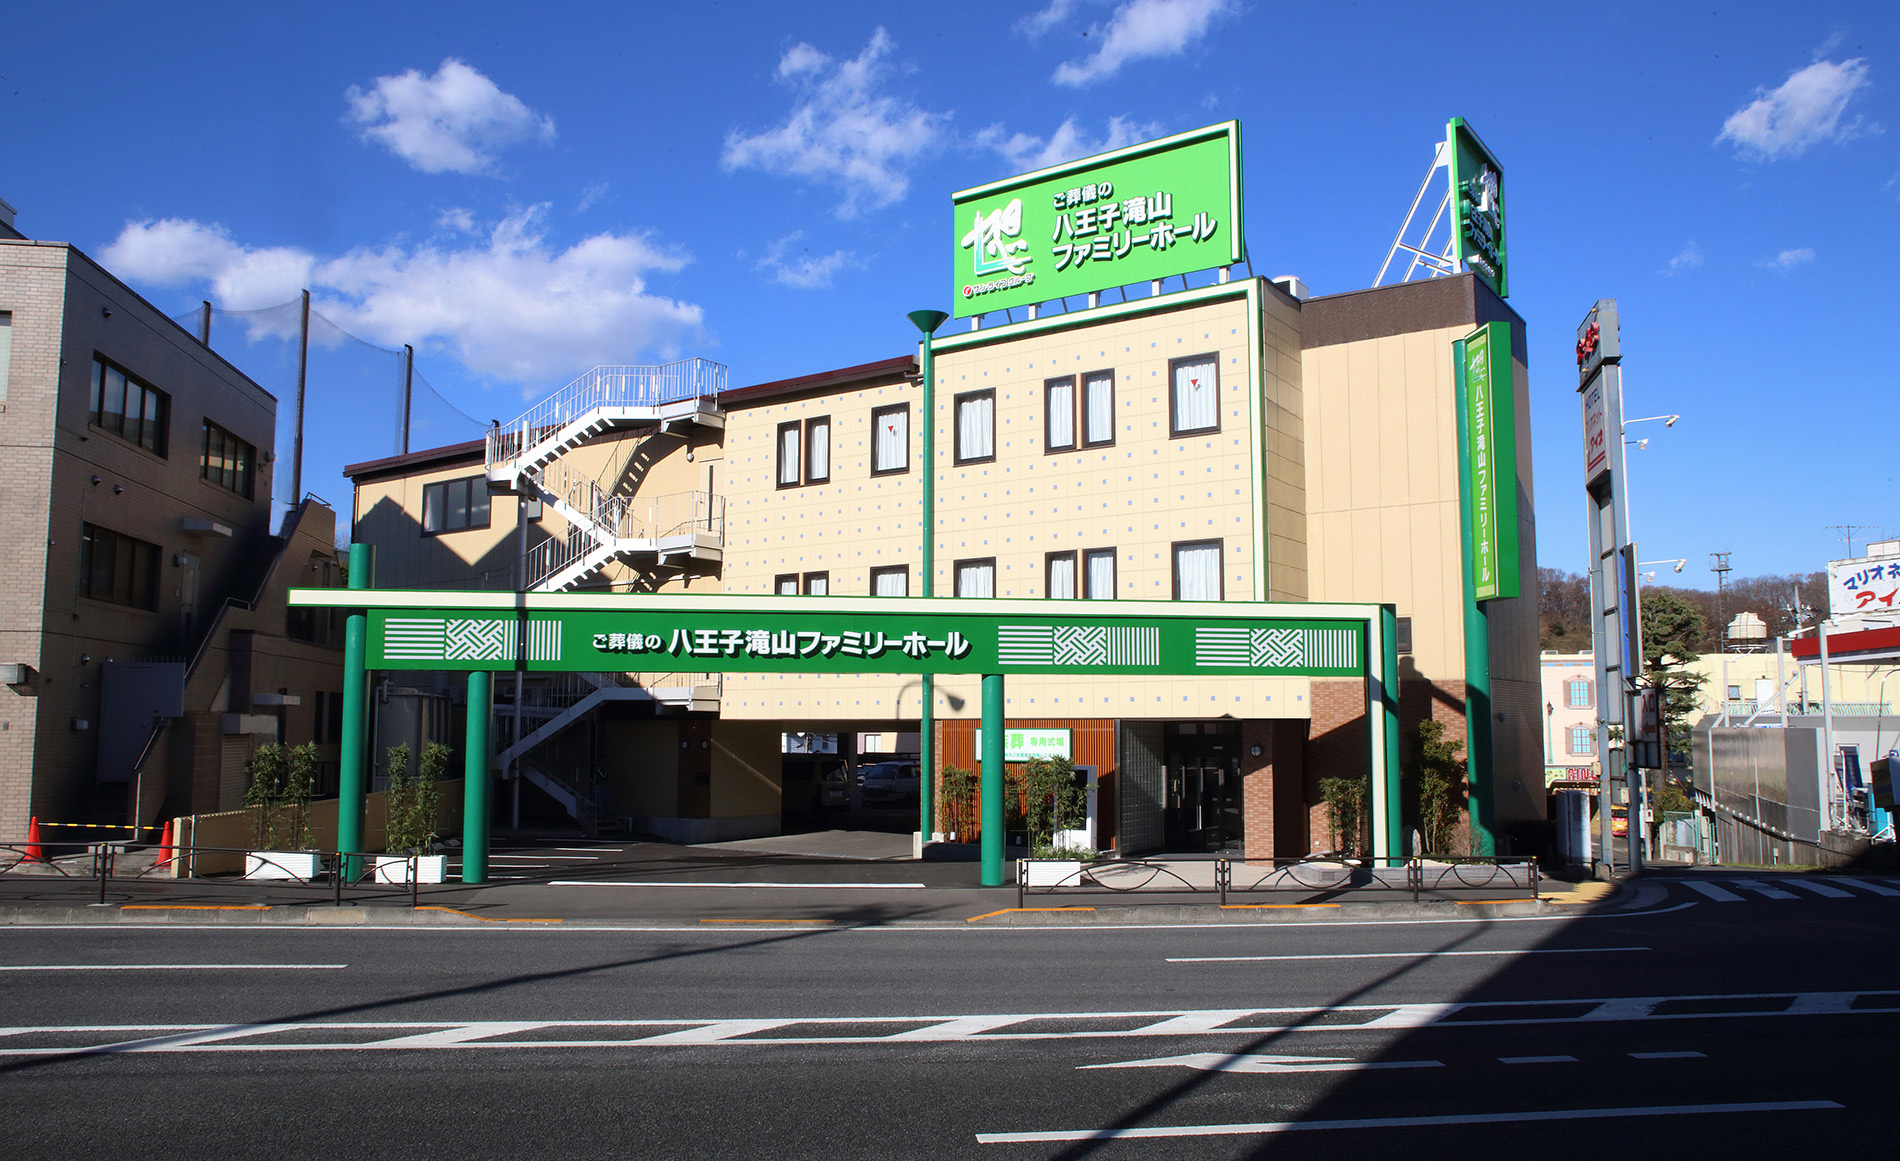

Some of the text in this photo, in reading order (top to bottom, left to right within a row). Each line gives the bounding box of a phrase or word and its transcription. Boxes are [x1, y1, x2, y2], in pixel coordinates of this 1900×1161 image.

[1053, 181, 1113, 208] ご葬儀の
[1052, 191, 1173, 243] 八王子滝山
[1052, 212, 1218, 272] ファミリーホール
[1474, 384, 1490, 582] 八王子滝山ファミリーホール
[1855, 587, 1900, 609] アイ
[592, 628, 969, 657] ご葬儀の 八王子滝山ファミリーホール
